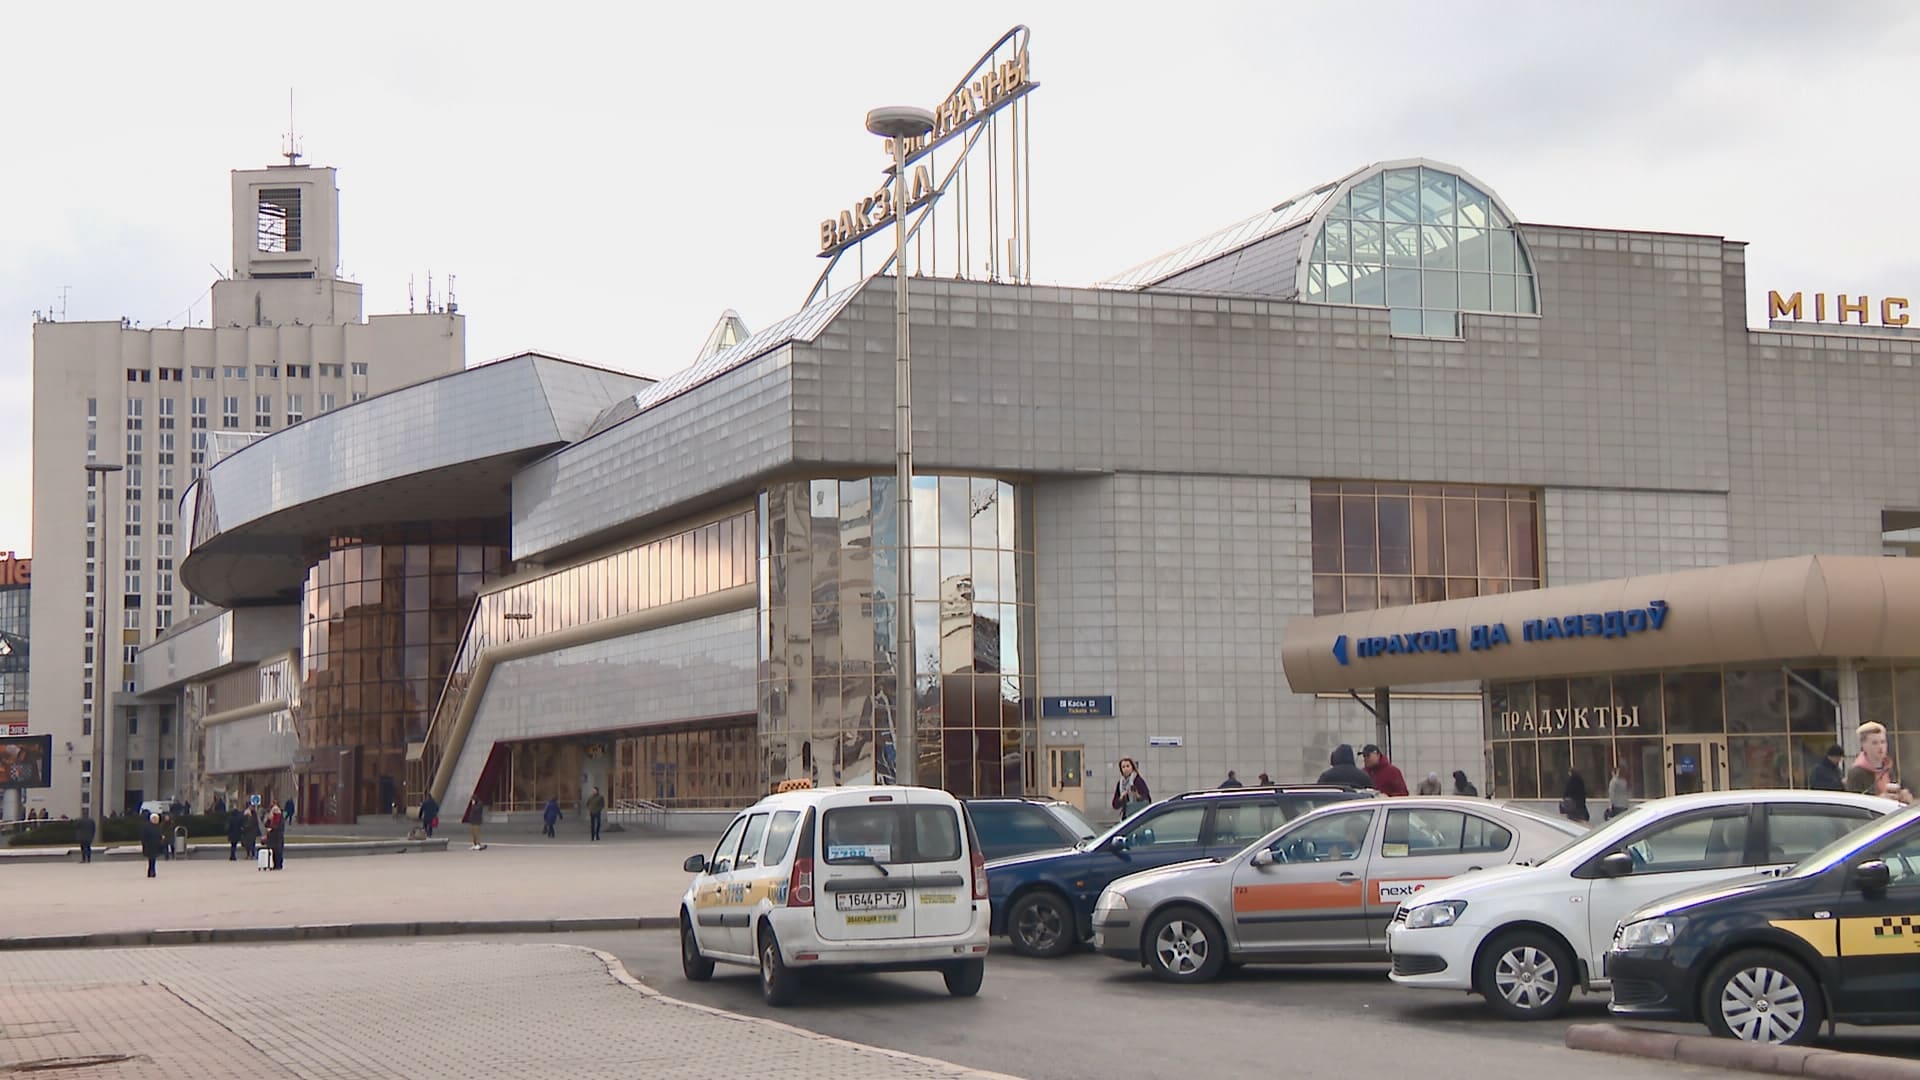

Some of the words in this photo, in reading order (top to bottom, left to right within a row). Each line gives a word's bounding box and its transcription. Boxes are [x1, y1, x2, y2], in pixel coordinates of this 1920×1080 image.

[1356, 627, 1459, 658] ПРАХОД
[1470, 622, 1511, 651] ДА
[1522, 600, 1669, 642] ПАЯЗДОЎ
[1501, 706, 1640, 735] ПРАДУКТЫ
